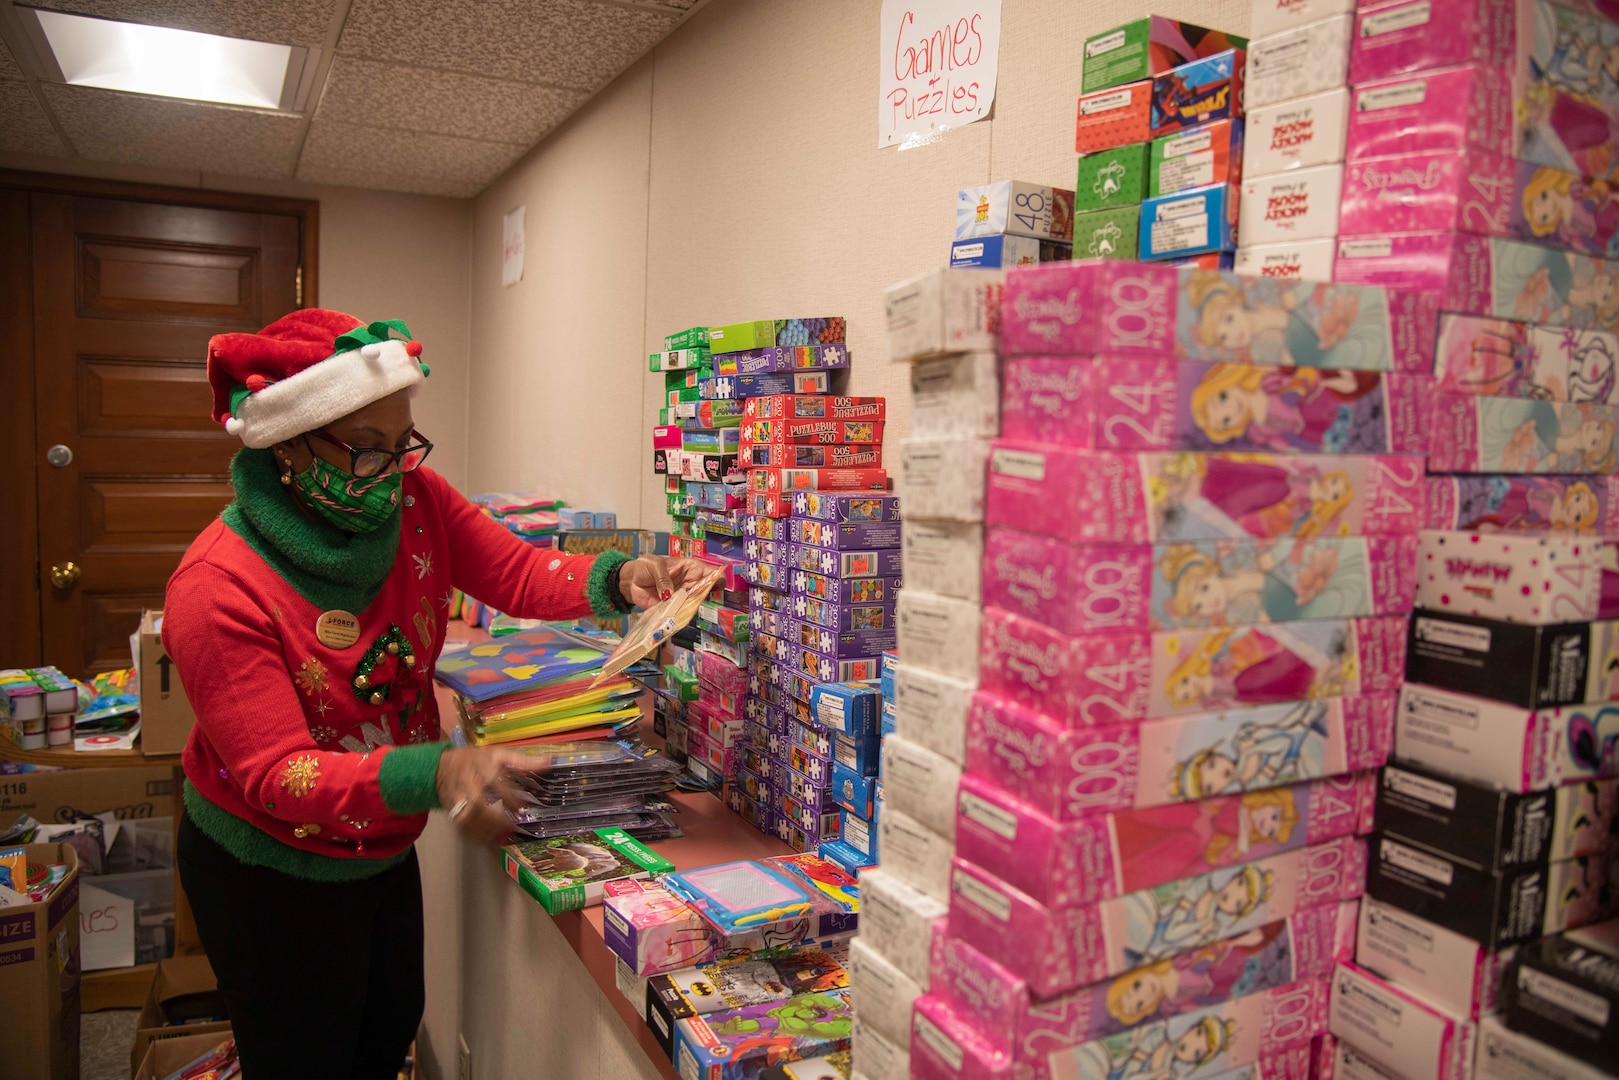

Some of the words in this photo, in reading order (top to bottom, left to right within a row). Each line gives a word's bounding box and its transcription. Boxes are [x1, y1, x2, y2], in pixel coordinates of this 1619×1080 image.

[895, 11, 982, 81] Games
[886, 79, 980, 131] Puzzles
[1269, 132, 1313, 151] MICKEY
[1014, 193, 1045, 231] 48
[1042, 196, 1052, 233] PUZZLE
[1264, 205, 1308, 222] MICKEY
[1463, 176, 1500, 231] 24
[1110, 277, 1153, 347] 100
[664, 336, 672, 350] 24
[776, 348, 785, 368] 300
[833, 404, 880, 418] PUZZLEBUG
[834, 397, 852, 407] 500
[1104, 380, 1160, 445] 24
[790, 422, 838, 435] PUZZLEBUG
[818, 433, 836, 443] 500
[832, 454, 877, 466] PUZZLEBUG
[833, 446, 851, 455] 500
[1374, 461, 1418, 519] 24
[1083, 560, 1127, 630] 100
[1550, 556, 1591, 619] 24
[1081, 658, 1139, 725] 24
[1067, 741, 1127, 812] 100
[604, 832, 630, 845] 24
[1303, 838, 1342, 897] 100
[610, 880, 640, 896] 300
[0, 920, 31, 938] IZE
[1268, 984, 1311, 1042] 100
